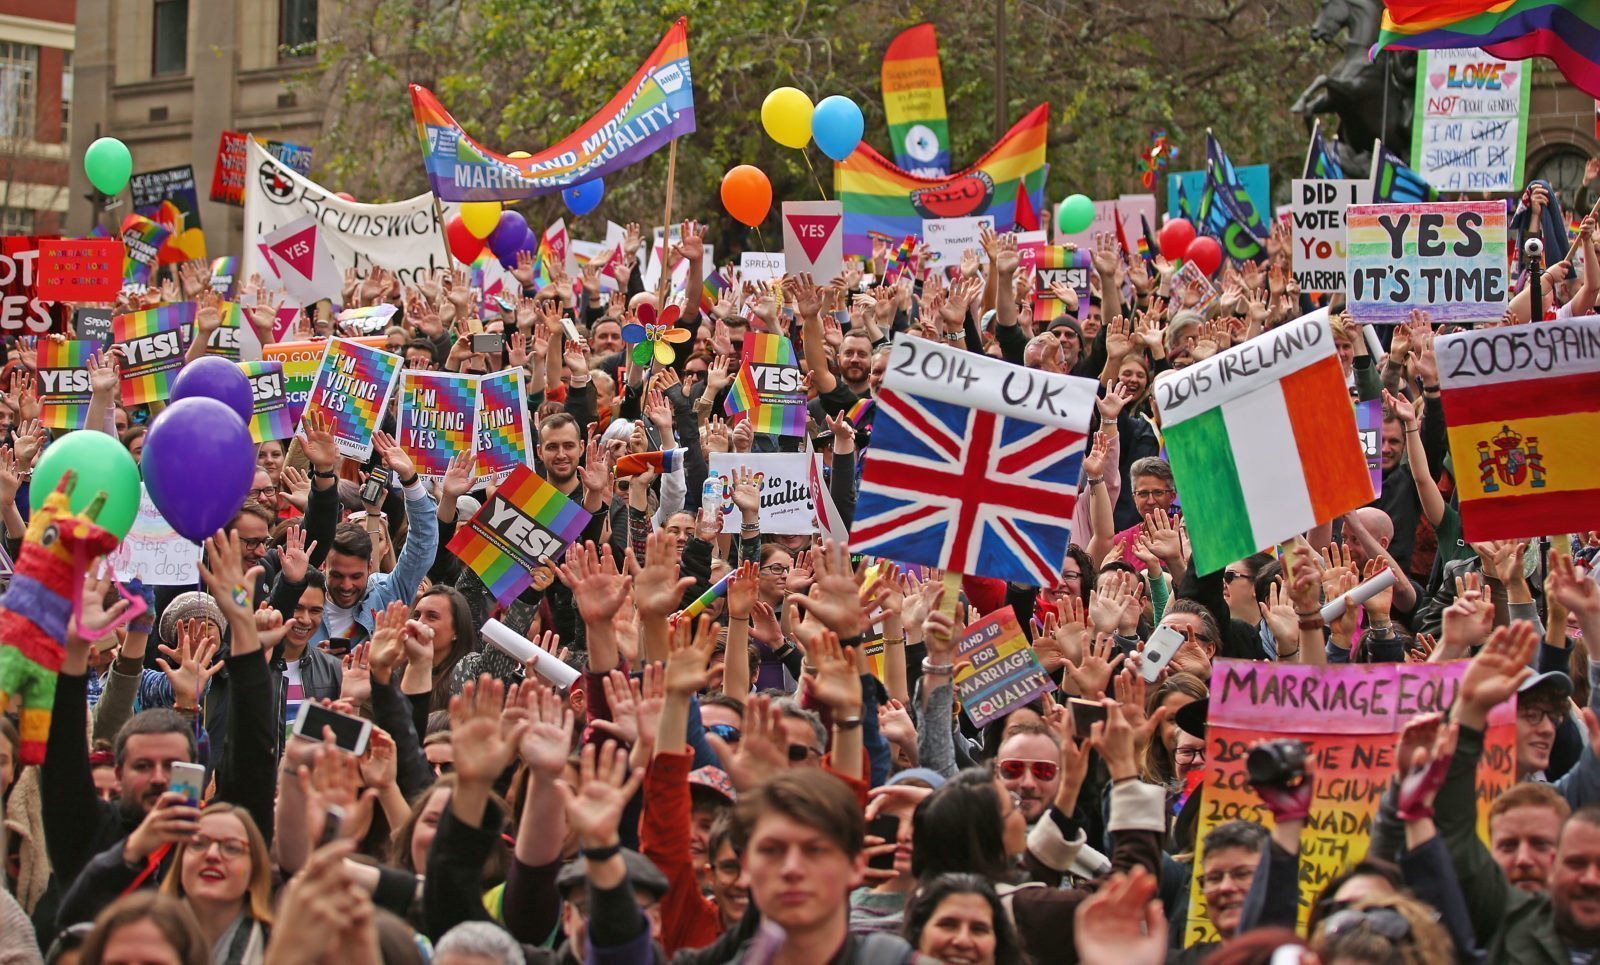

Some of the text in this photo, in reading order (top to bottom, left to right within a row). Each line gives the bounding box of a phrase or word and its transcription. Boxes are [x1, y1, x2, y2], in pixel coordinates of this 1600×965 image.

[660, 71, 681, 85] ANMF
[1447, 62, 1506, 91] LOVE
[1428, 96, 1460, 113] NOT
[1445, 123, 1462, 141] AM
[531, 151, 577, 173] AND
[1303, 183, 1337, 205] DID
[300, 187, 450, 237] Brunswick
[1293, 210, 1339, 229] VOTE
[799, 224, 825, 238] YES
[1378, 212, 1483, 258] YES
[285, 240, 310, 260] YES
[0, 250, 39, 286] OT
[745, 260, 780, 269] SPREAD
[1038, 269, 1087, 288] YES!
[1354, 265, 1505, 303] IT'S TIME
[0, 292, 54, 332] ES
[84, 316, 111, 327] SPEND
[120, 331, 181, 366] YES!
[267, 353, 287, 364] NO
[1448, 333, 1533, 378] 2005
[331, 353, 357, 375] I'M
[893, 342, 979, 391] 2014
[1158, 321, 1322, 411] 2015 IRELAND
[250, 374, 282, 401] ES!
[326, 371, 378, 401] VOTING
[321, 389, 346, 412] YES
[412, 388, 437, 408] I'M
[411, 408, 465, 431] VOTING
[409, 429, 437, 449] YES
[478, 431, 493, 451] ES
[769, 476, 781, 489] to
[488, 496, 562, 565] YES!
[986, 623, 999, 637] UP
[972, 647, 995, 665] FOR
[960, 649, 1033, 697] MARRIAGE
[968, 671, 1046, 722] EQUALITY
[1221, 668, 1459, 716] MARRIAGE EQU
[1317, 778, 1386, 804] LGIUM
[1301, 837, 1349, 864] UTH
